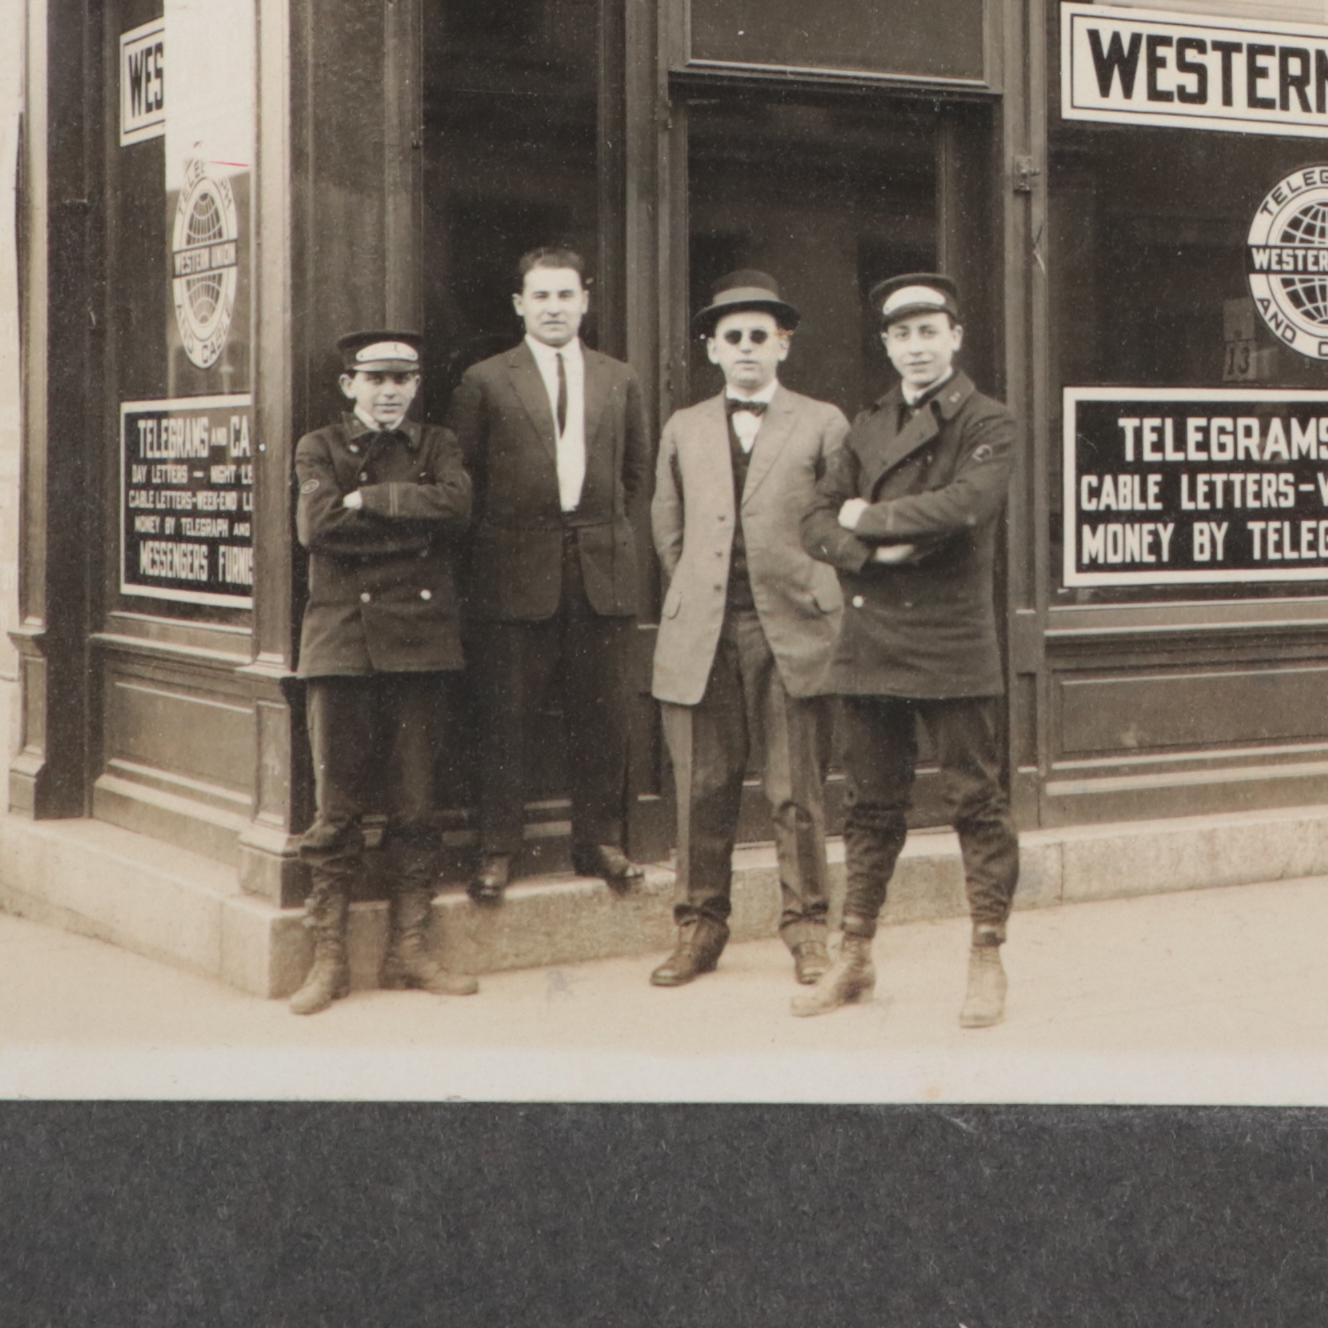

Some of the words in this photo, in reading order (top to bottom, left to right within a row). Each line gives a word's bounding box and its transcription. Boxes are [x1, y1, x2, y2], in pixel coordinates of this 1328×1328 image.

[1257, 297, 1297, 344] AND
[138, 417, 208, 459] TELEGRAMS
[230, 415, 250, 457] CA
[132, 464, 147, 484] DAY
[151, 464, 188, 484] LETTERS
[1081, 475, 1163, 511] CABLE
[129, 490, 154, 509] CABLE
[135, 515, 160, 534] MONEY
[181, 517, 229, 538] TELEGRAPH
[1082, 523, 1174, 564] MONEY
[1193, 523, 1228, 562] BY
[140, 540, 208, 582] MESSENGERS
